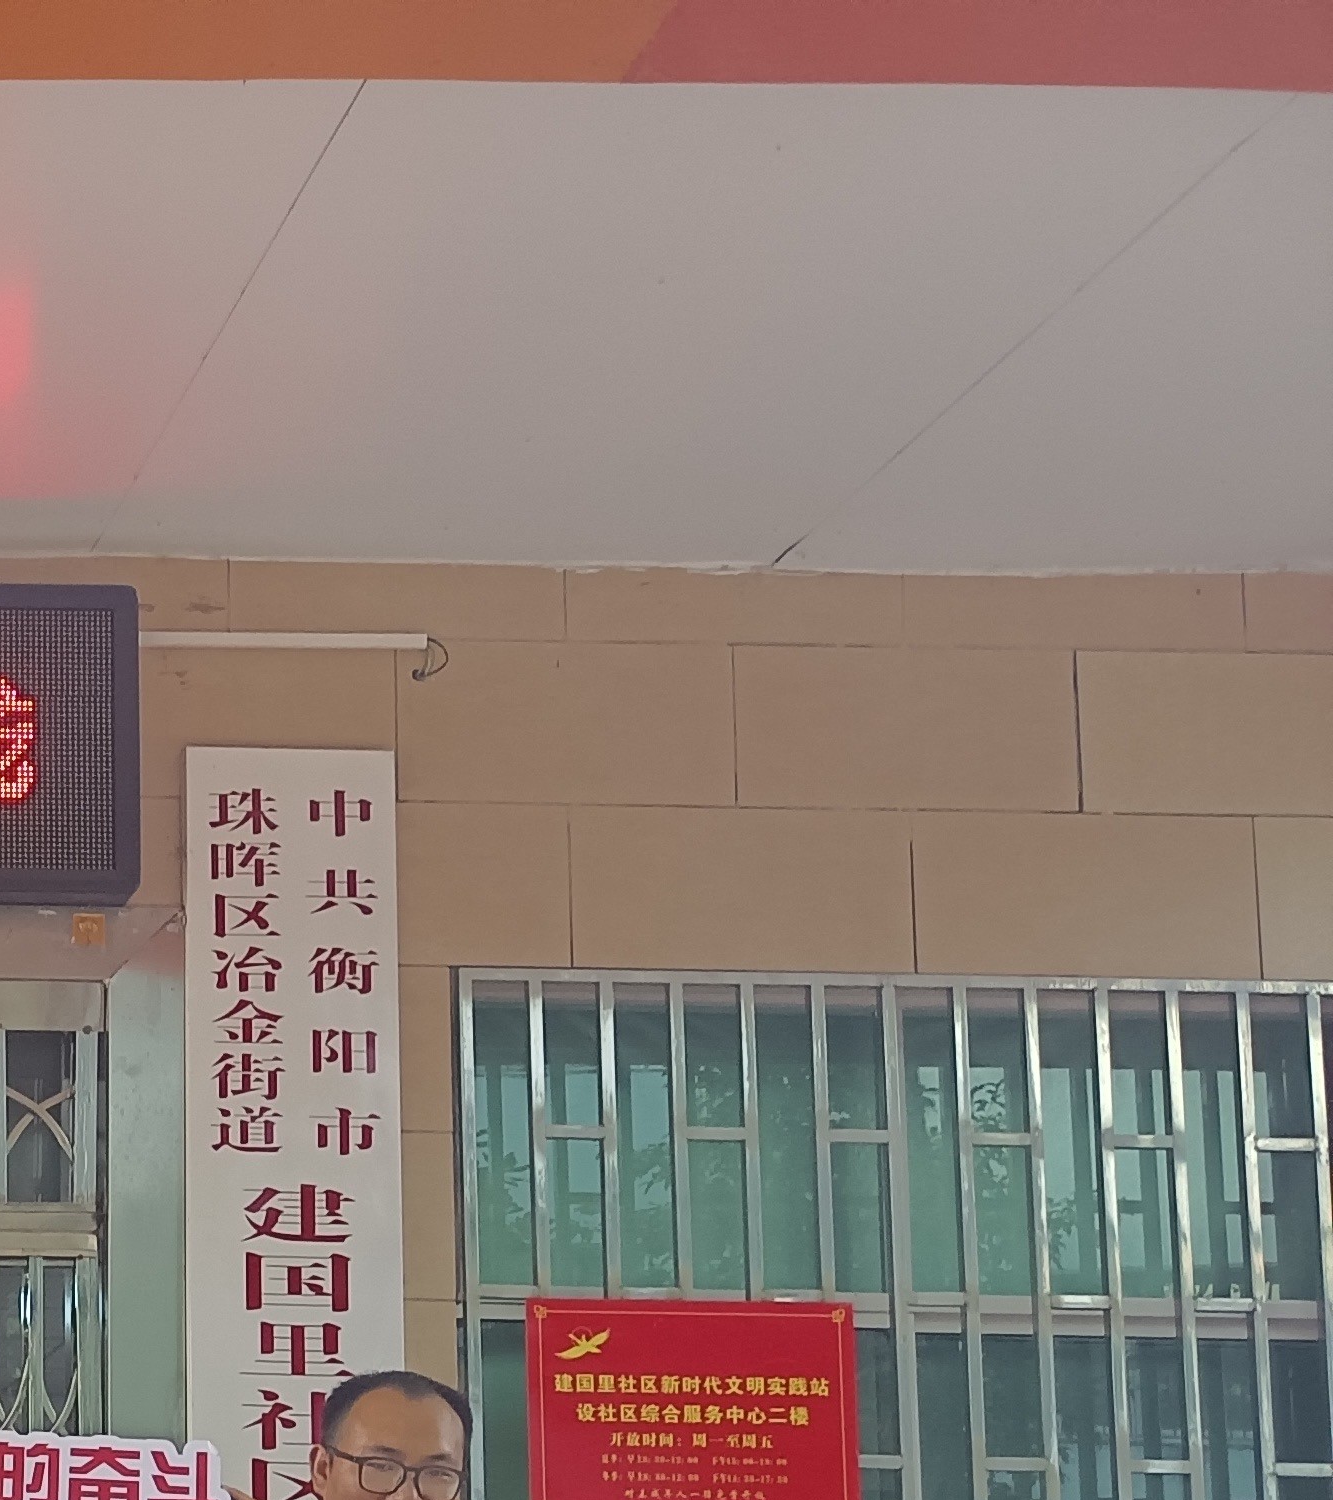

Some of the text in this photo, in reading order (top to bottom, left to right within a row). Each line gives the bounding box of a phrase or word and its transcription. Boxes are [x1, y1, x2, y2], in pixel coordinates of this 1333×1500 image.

[208, 787, 285, 1154] 珠晖区冶金街道
[305, 789, 382, 1156] 中共衡阳市
[554, 1373, 830, 1397] 建国里社区新时代文明实践站
[576, 1404, 809, 1427] 设社区综合服务中心二楼
